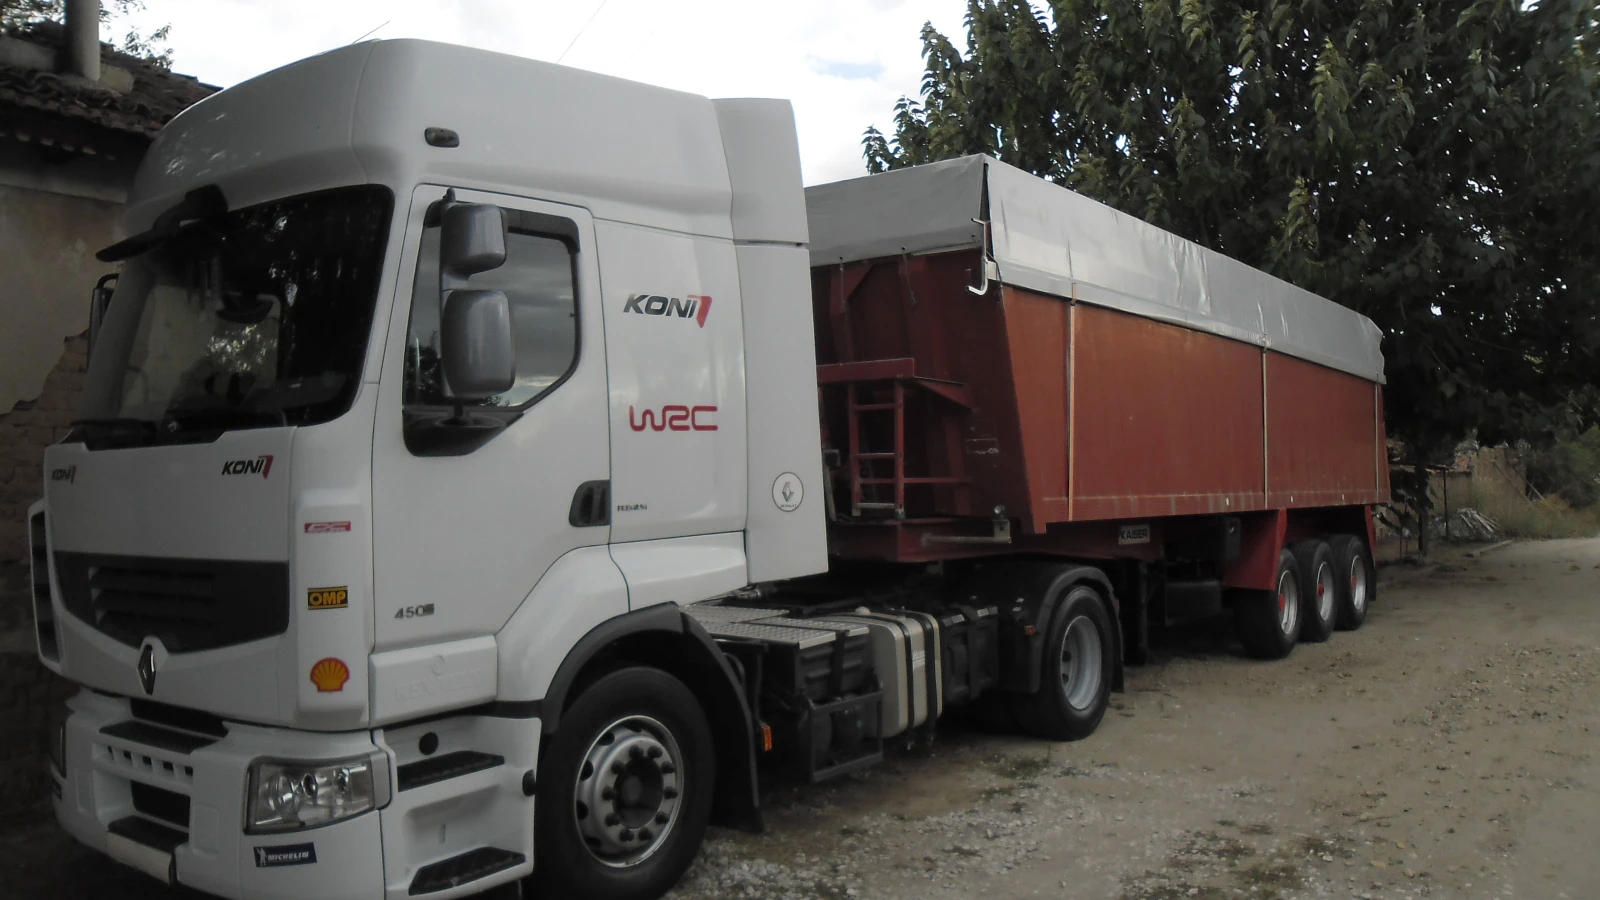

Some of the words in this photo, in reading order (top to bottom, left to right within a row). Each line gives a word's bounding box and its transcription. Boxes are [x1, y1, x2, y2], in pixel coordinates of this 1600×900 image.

[623, 294, 698, 319] KONI
[629, 405, 718, 432] WRC
[221, 459, 265, 476] KONI
[1120, 529, 1148, 540] KAISER
[310, 591, 346, 606] OMP
[394, 605, 425, 619] 450
[267, 851, 310, 861] MICHELIN
